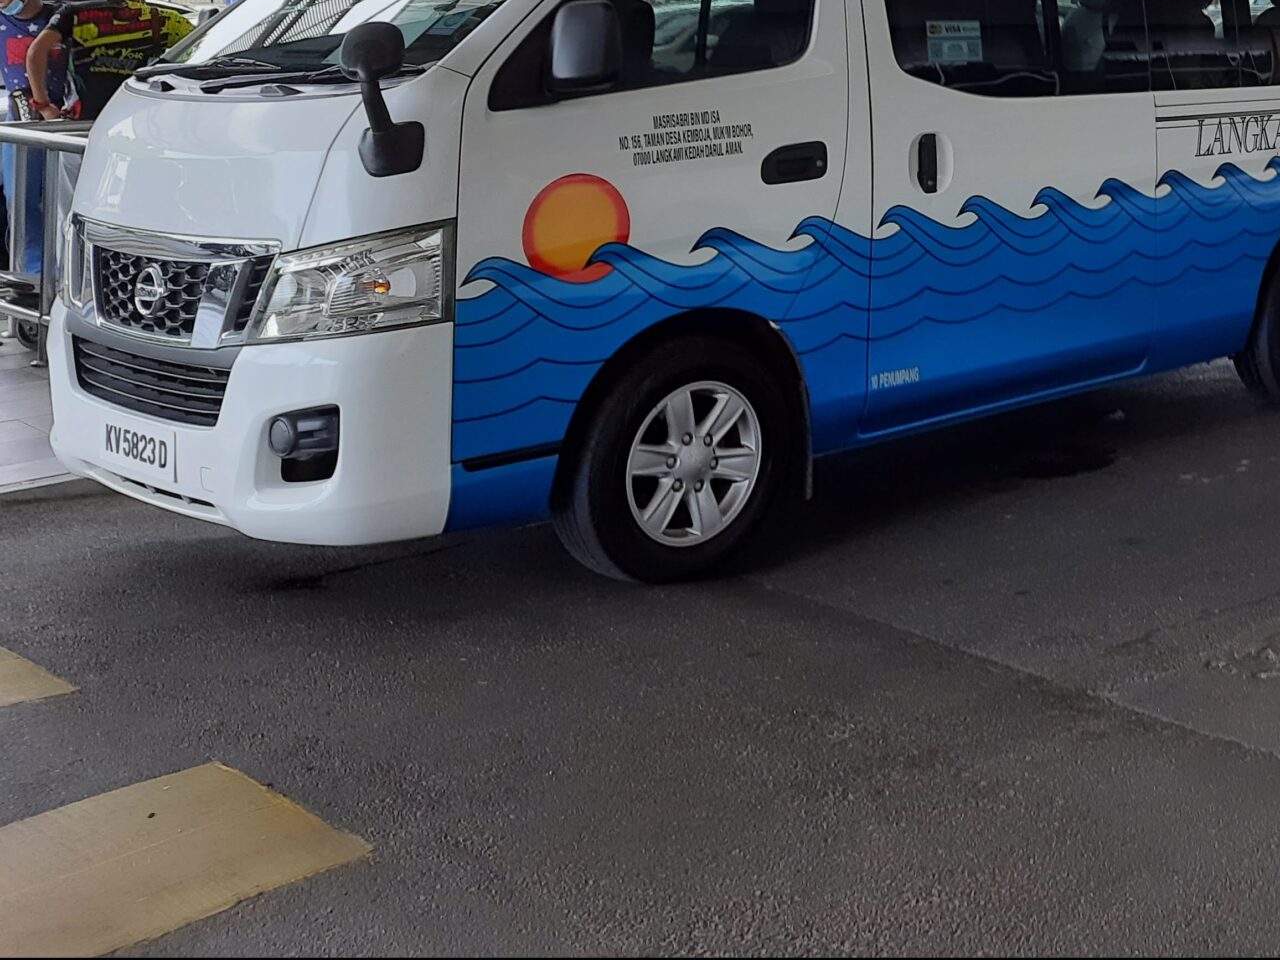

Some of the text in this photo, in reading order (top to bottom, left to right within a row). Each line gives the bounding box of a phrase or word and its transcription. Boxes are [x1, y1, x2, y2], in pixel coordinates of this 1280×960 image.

[690, 112, 701, 126] BIN
[701, 111, 710, 125] MD
[710, 110, 721, 124] ISA
[619, 135, 631, 151] NO.
[643, 132, 665, 147] TAMAN
[665, 130, 682, 145] DESA
[682, 128, 712, 144] KEMBOJA,
[732, 123, 754, 139] BOHOR,
[632, 151, 651, 166] 07000
[651, 147, 684, 164] LANGKAWI
[683, 145, 705, 160] KEDAH
[704, 143, 725, 158] DARUL
